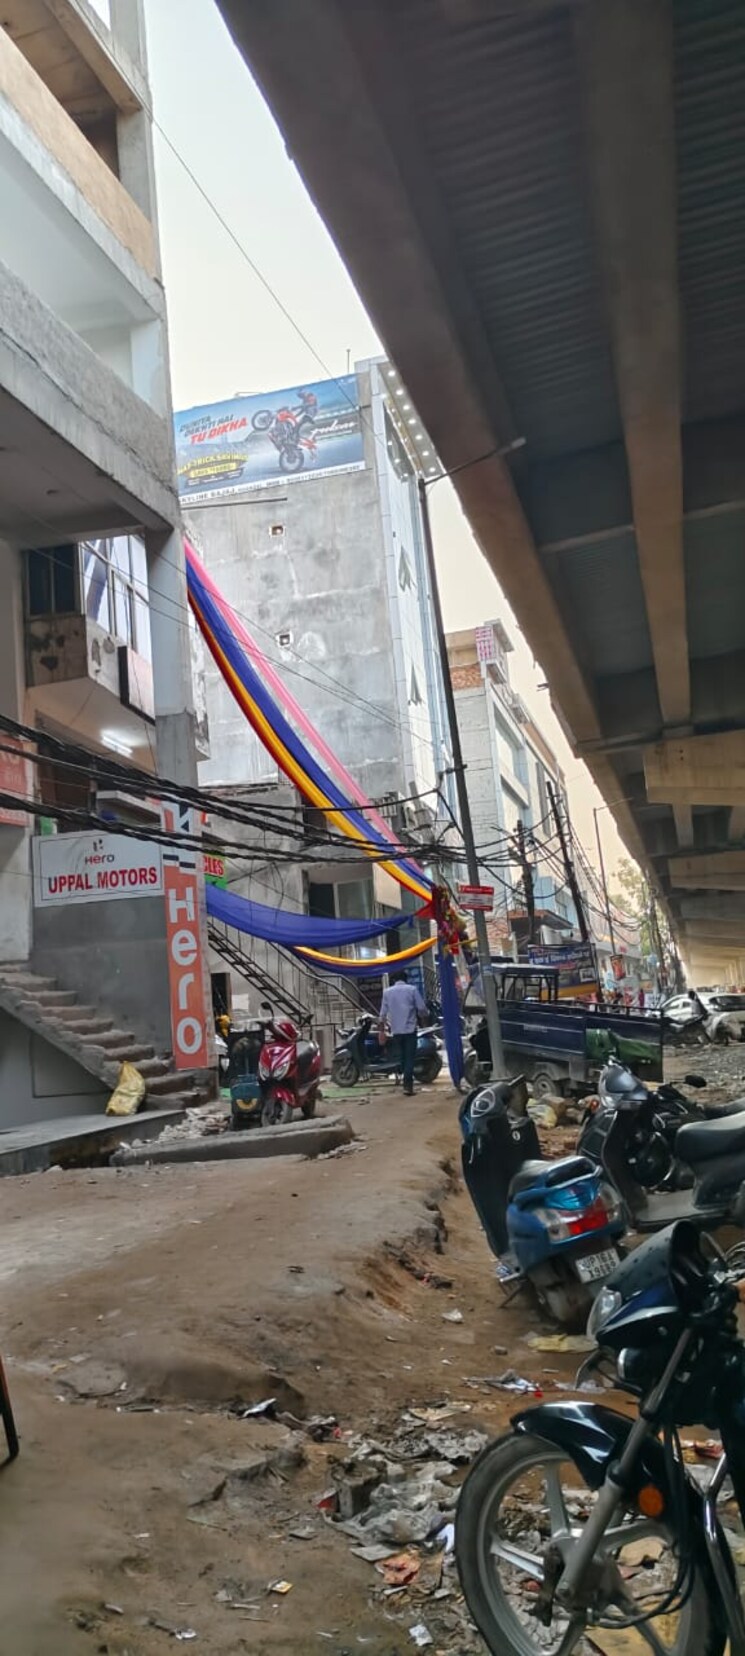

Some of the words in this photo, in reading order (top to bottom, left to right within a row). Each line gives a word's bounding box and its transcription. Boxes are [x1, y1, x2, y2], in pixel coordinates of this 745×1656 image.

[191, 431, 207, 446] TU
[208, 416, 248, 439] DIKHA
[48, 872, 93, 894] UPPAL
[97, 866, 158, 890] MOTORS
[168, 886, 203, 1055] Hero
